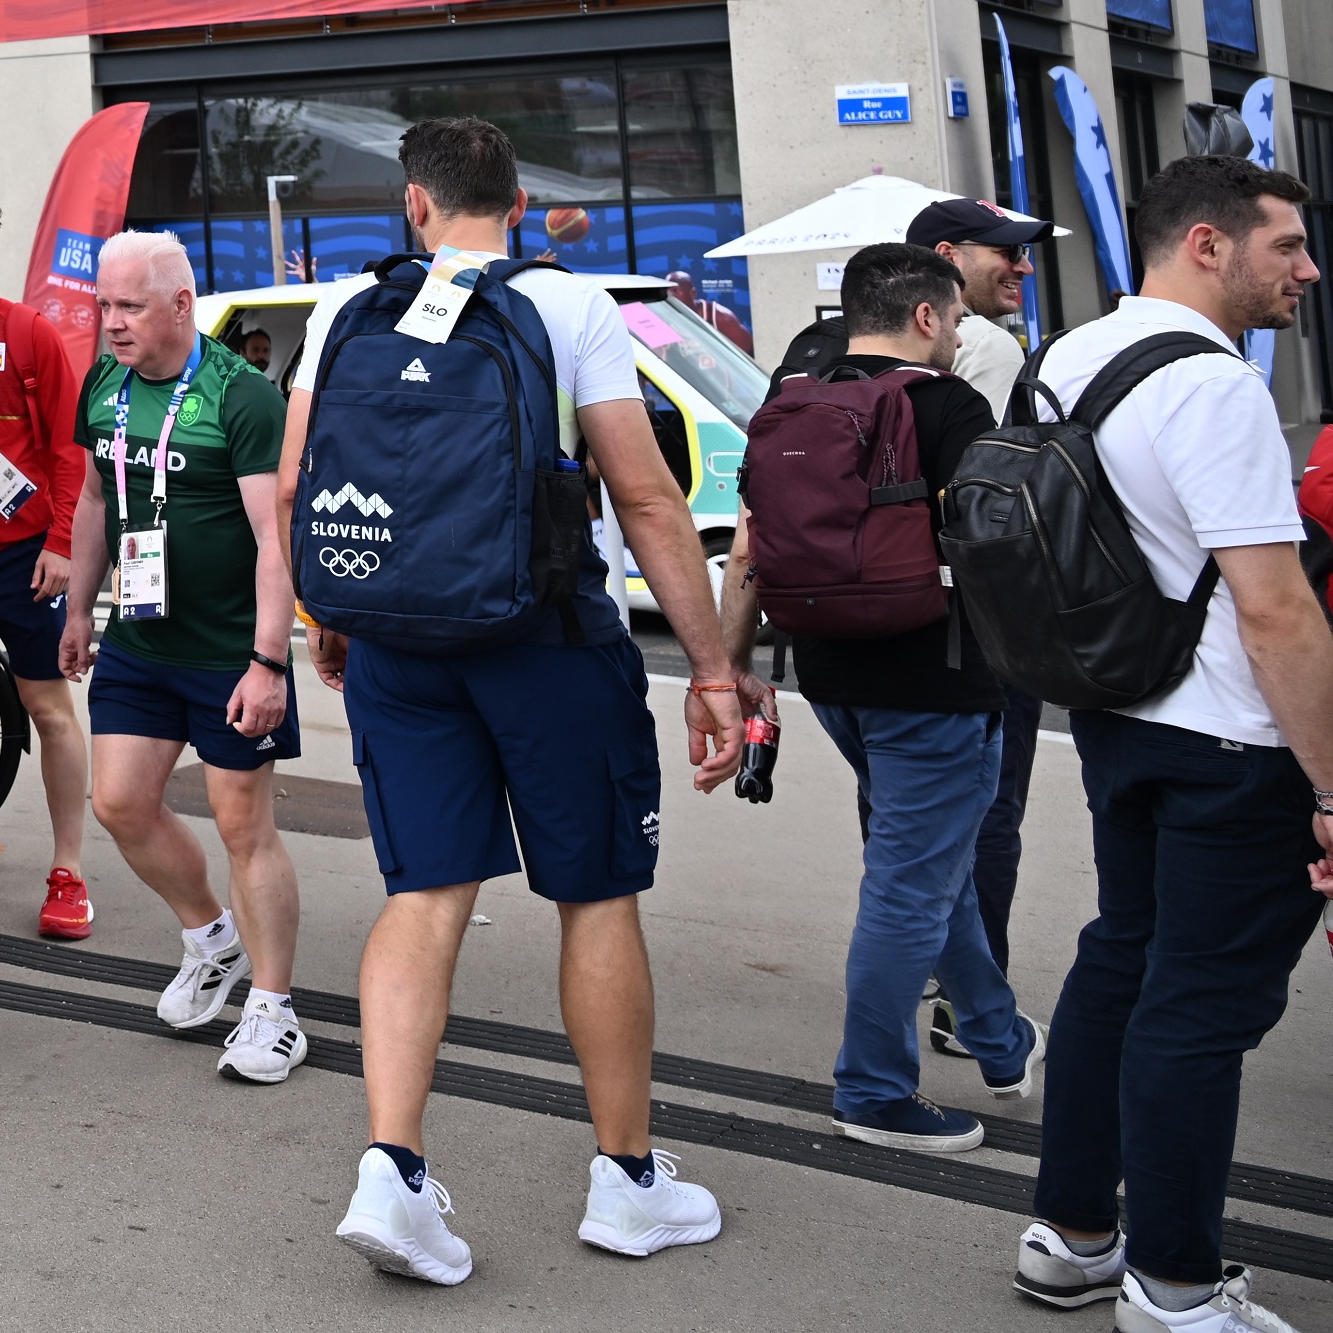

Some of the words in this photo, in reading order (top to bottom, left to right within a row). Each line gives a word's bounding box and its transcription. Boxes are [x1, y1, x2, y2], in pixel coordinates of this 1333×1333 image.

[863, 99, 883, 109] Rue
[843, 111, 877, 121] ALICE
[879, 109, 903, 120] GUY
[67, 238, 91, 251] TEAM
[59, 247, 92, 274] USA
[47, 275, 63, 287] ONE
[64, 279, 81, 291] FOR
[81, 283, 98, 295] ALL
[422, 303, 448, 317] SLO
[311, 521, 392, 543] SLOVENIA
